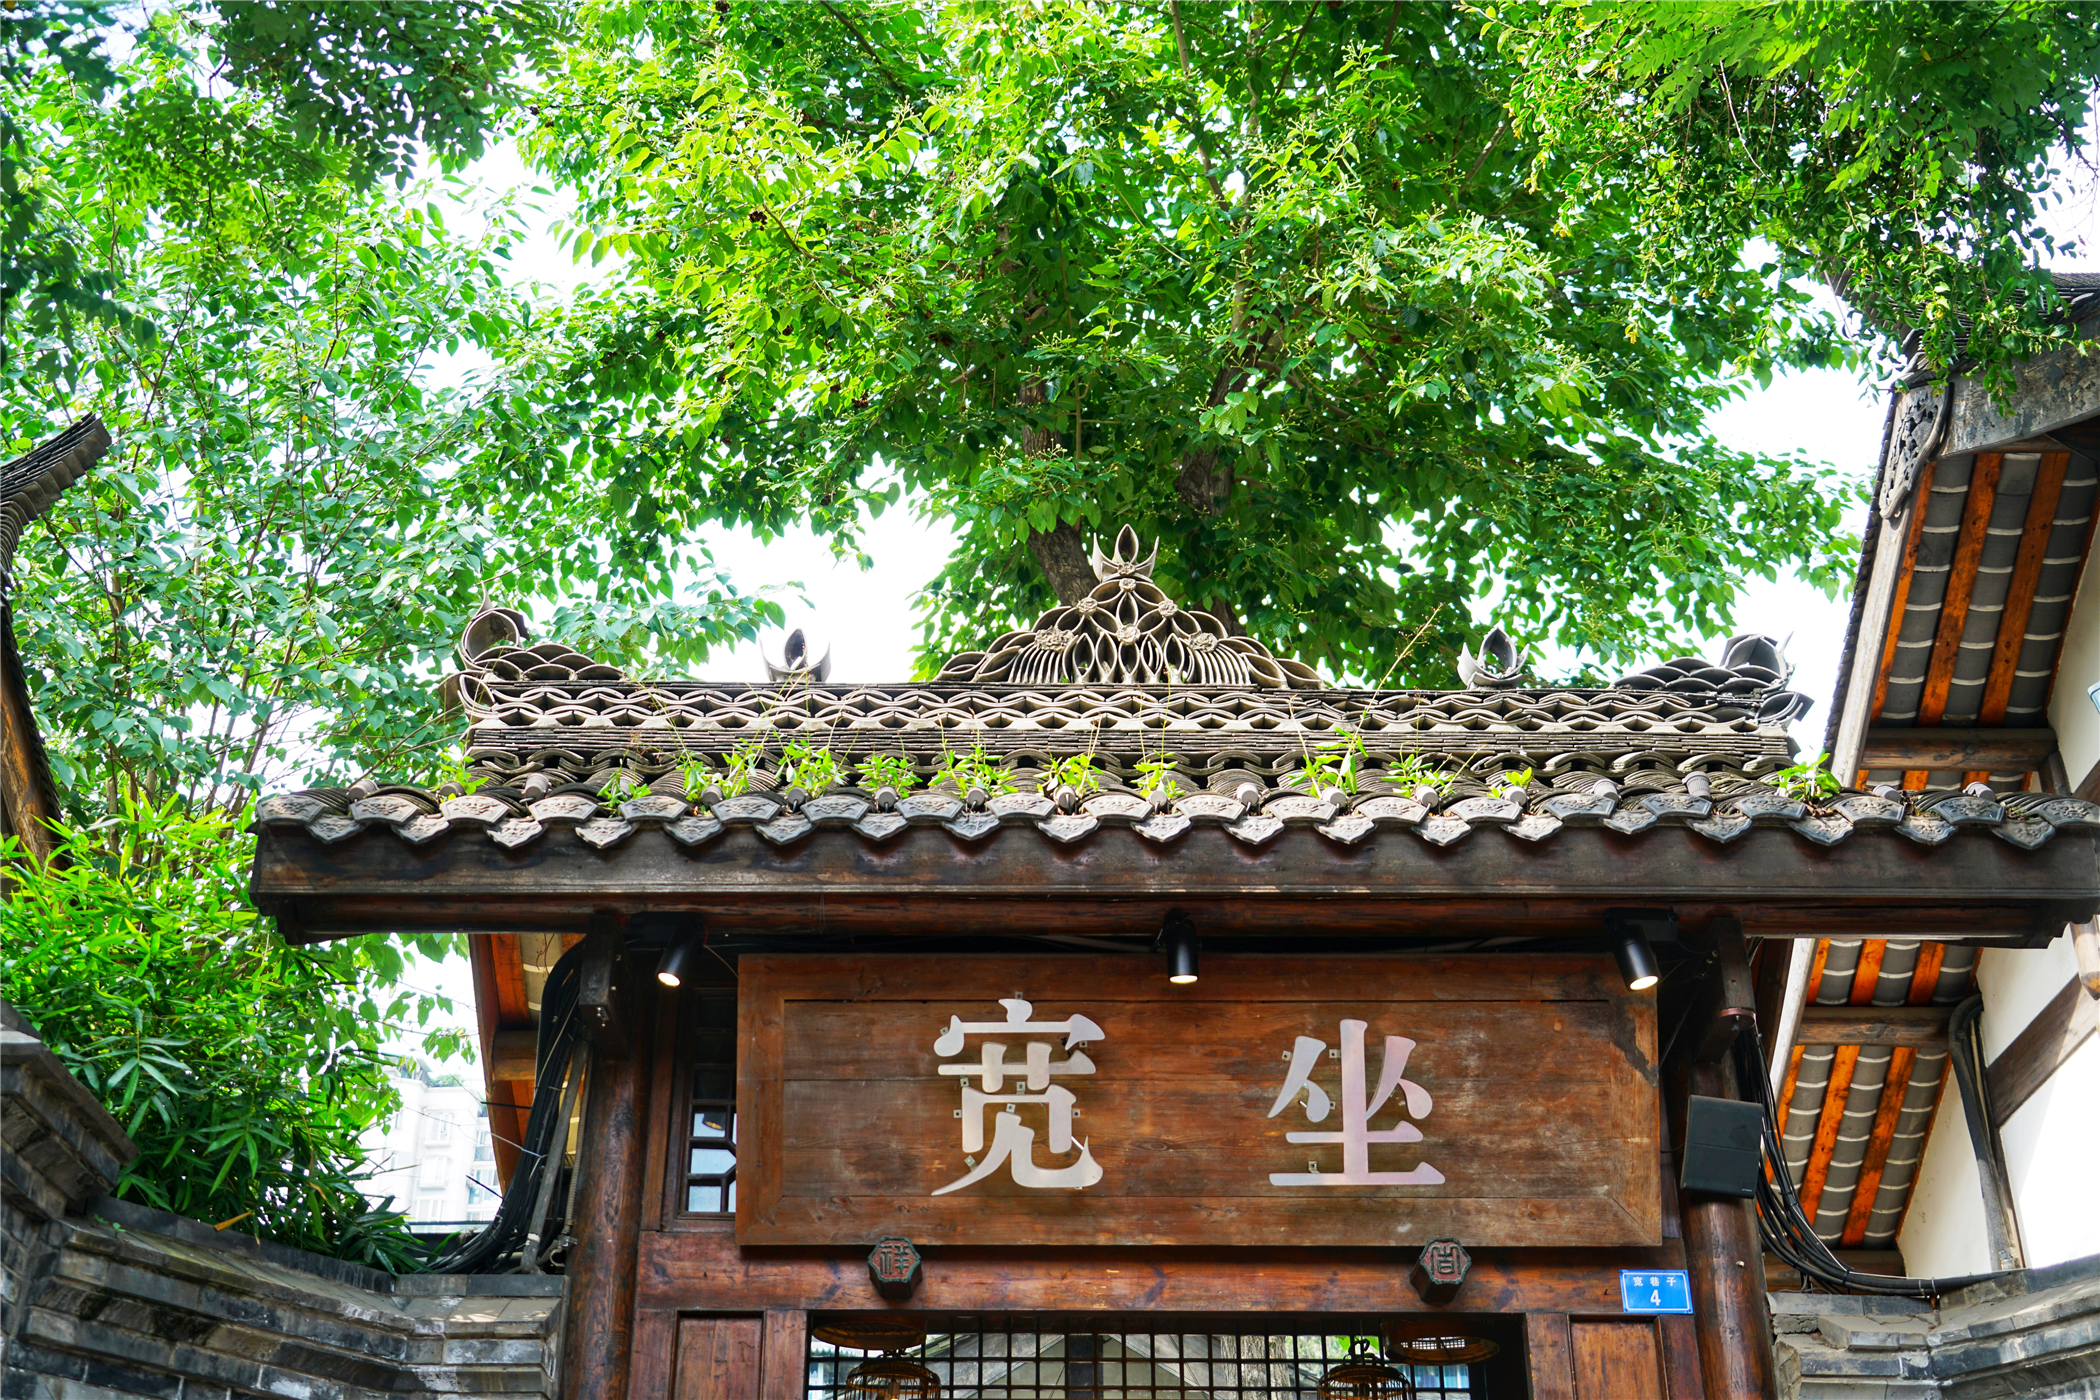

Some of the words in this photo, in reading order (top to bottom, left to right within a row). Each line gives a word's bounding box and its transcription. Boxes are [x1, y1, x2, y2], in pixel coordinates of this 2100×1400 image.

[931, 998, 1446, 1196] 宽坐
[1632, 1276, 1677, 1287] 宽巷子
[1650, 1289, 1661, 1306] 4
